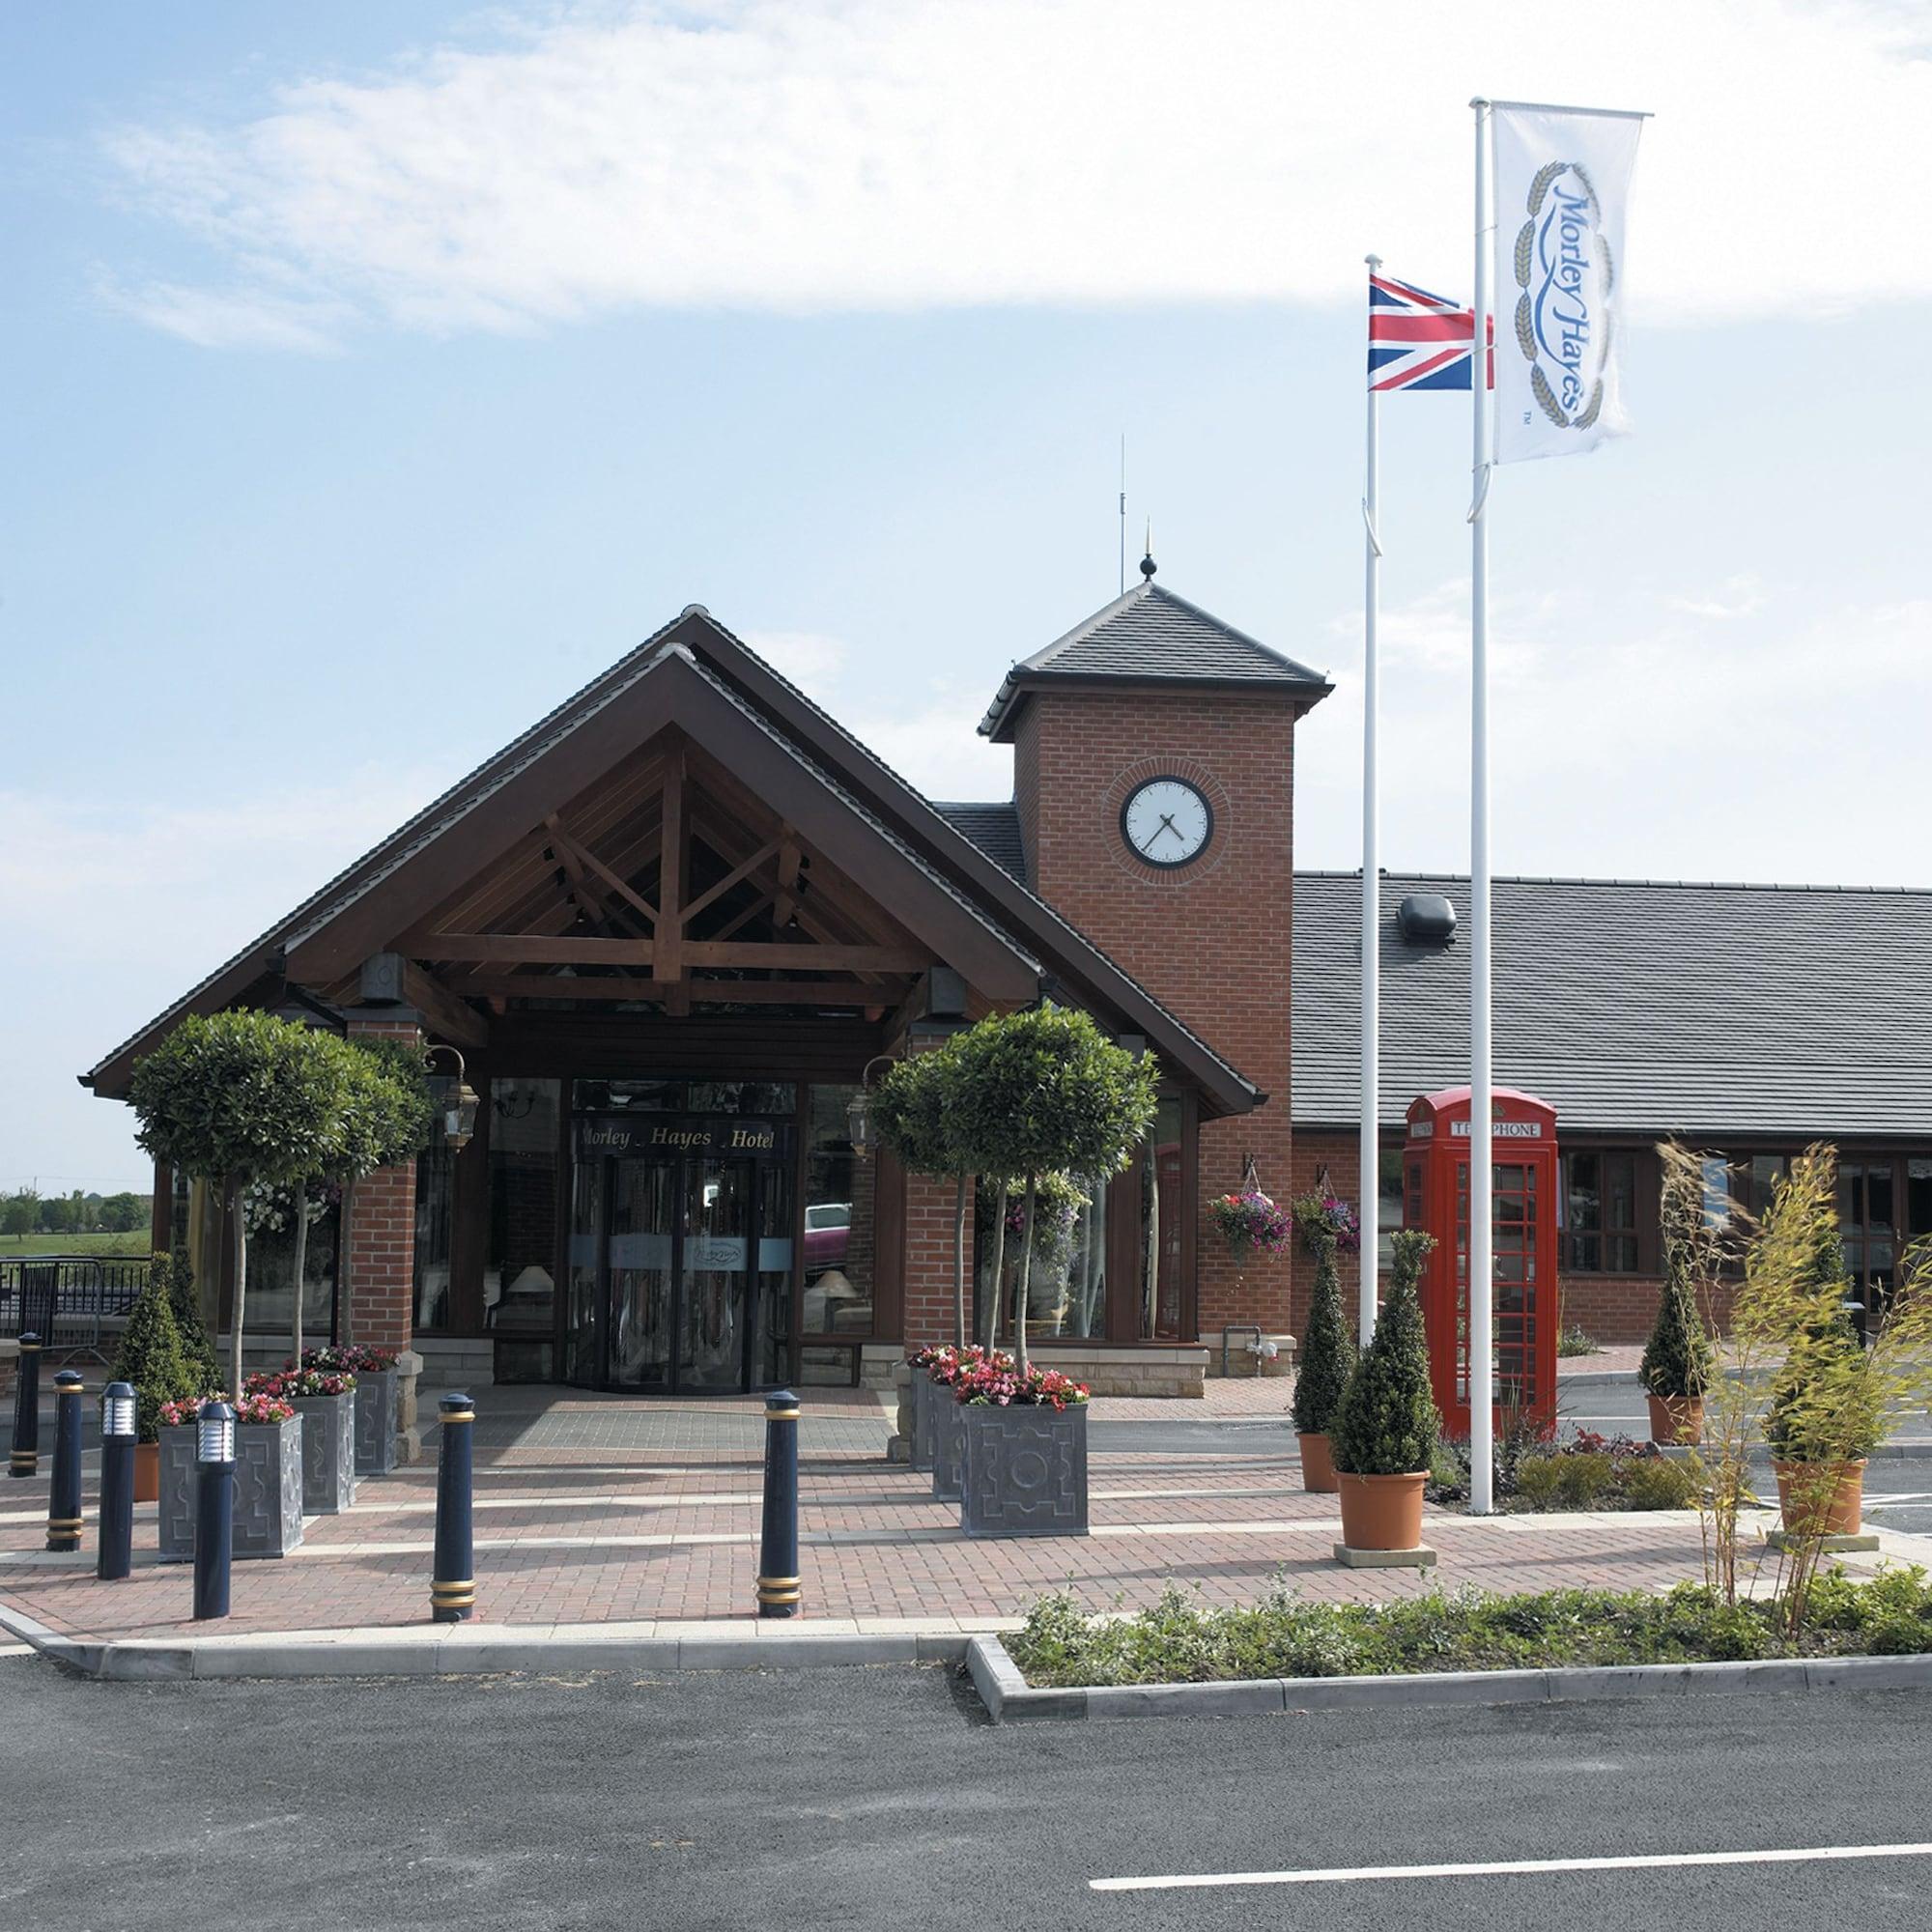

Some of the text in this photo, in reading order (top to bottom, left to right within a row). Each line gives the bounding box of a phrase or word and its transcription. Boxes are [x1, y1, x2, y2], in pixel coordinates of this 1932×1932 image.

[1552, 185, 1591, 412] Morley Hayes
[650, 1126, 712, 1151] Hayes
[731, 1129, 775, 1149] Hotel
[1455, 1122, 1537, 1137] TEPHONE
